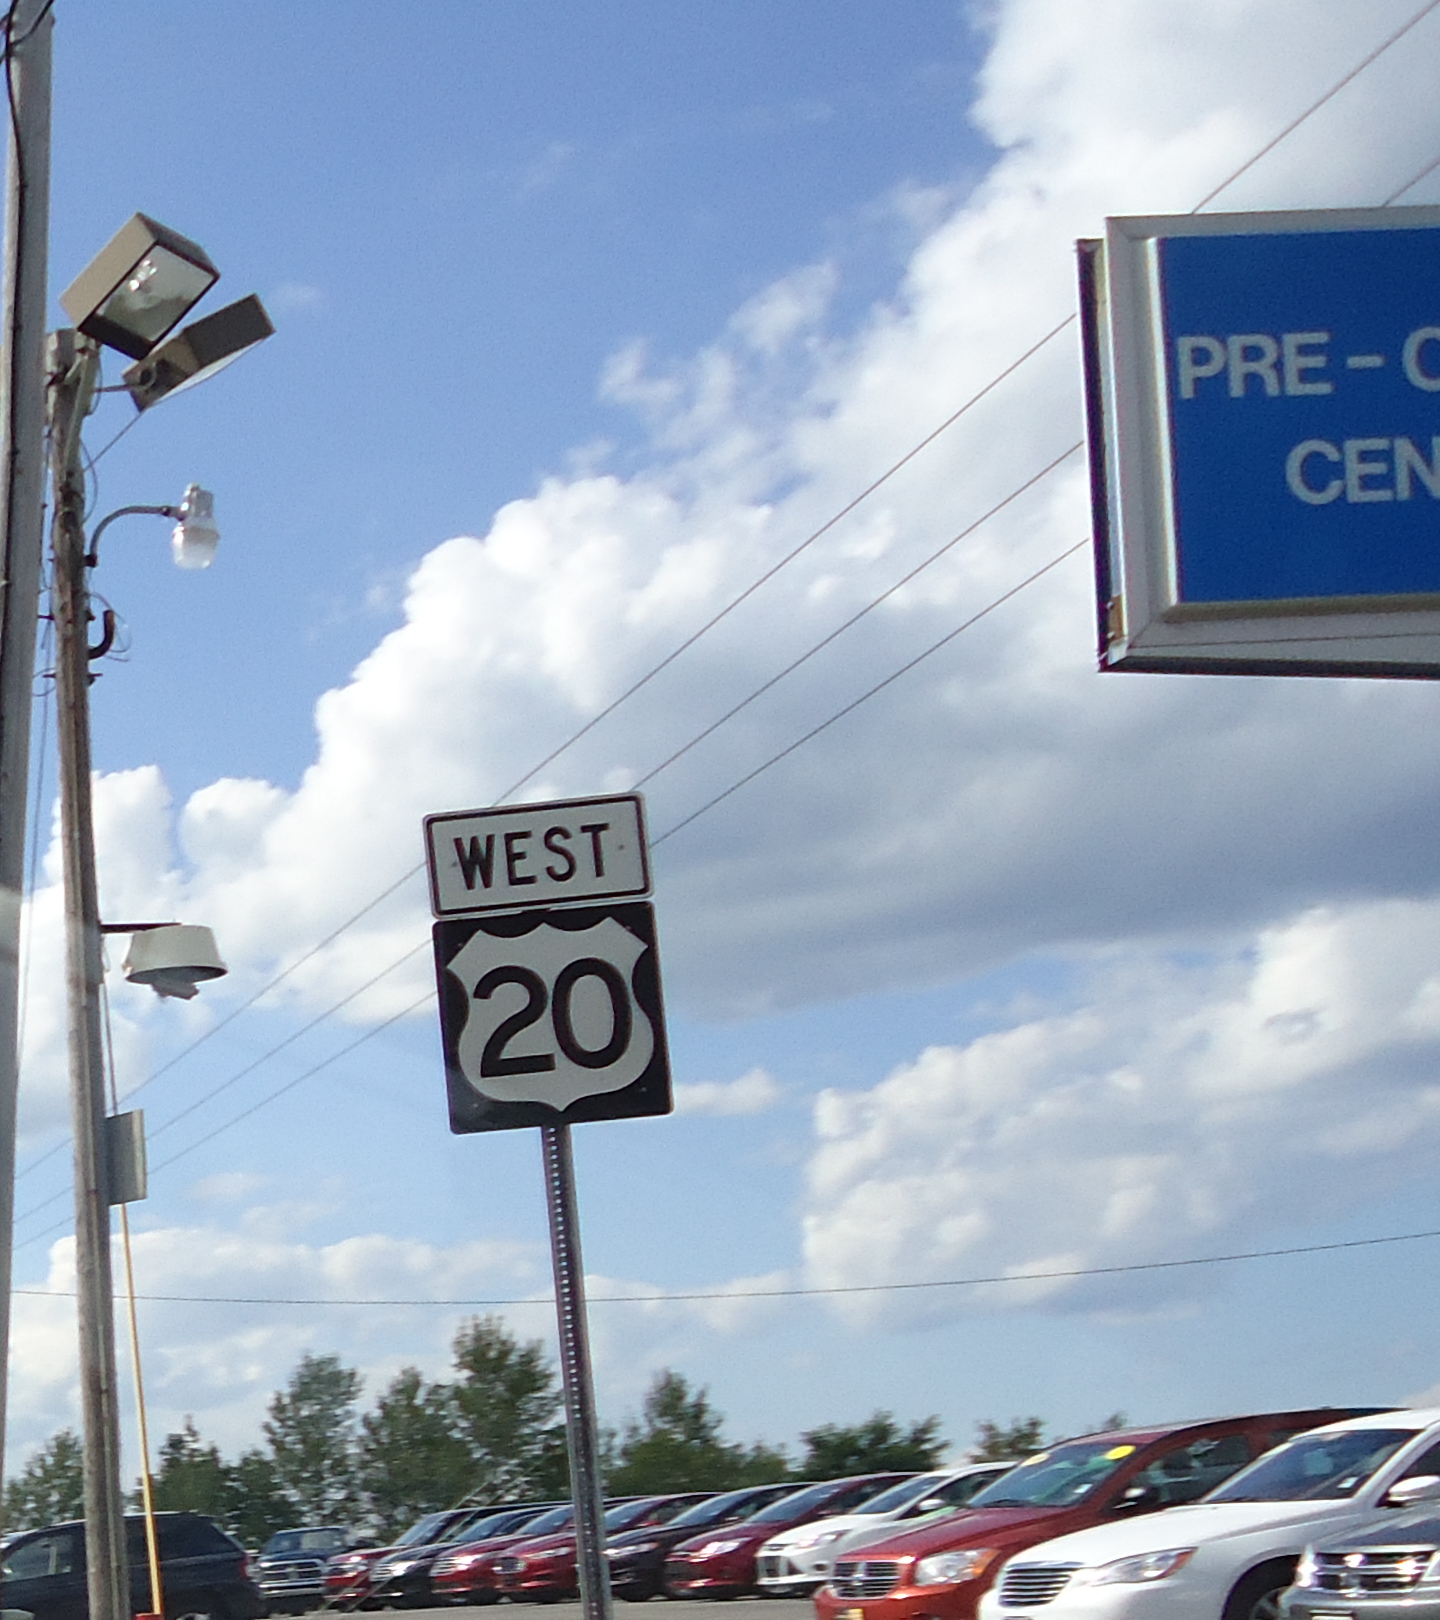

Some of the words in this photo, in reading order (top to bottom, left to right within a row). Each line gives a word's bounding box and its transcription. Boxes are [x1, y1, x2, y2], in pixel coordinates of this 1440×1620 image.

[1285, 435, 1440, 505] CEN
[452, 822, 611, 891] WEST
[473, 956, 633, 1079] 20
